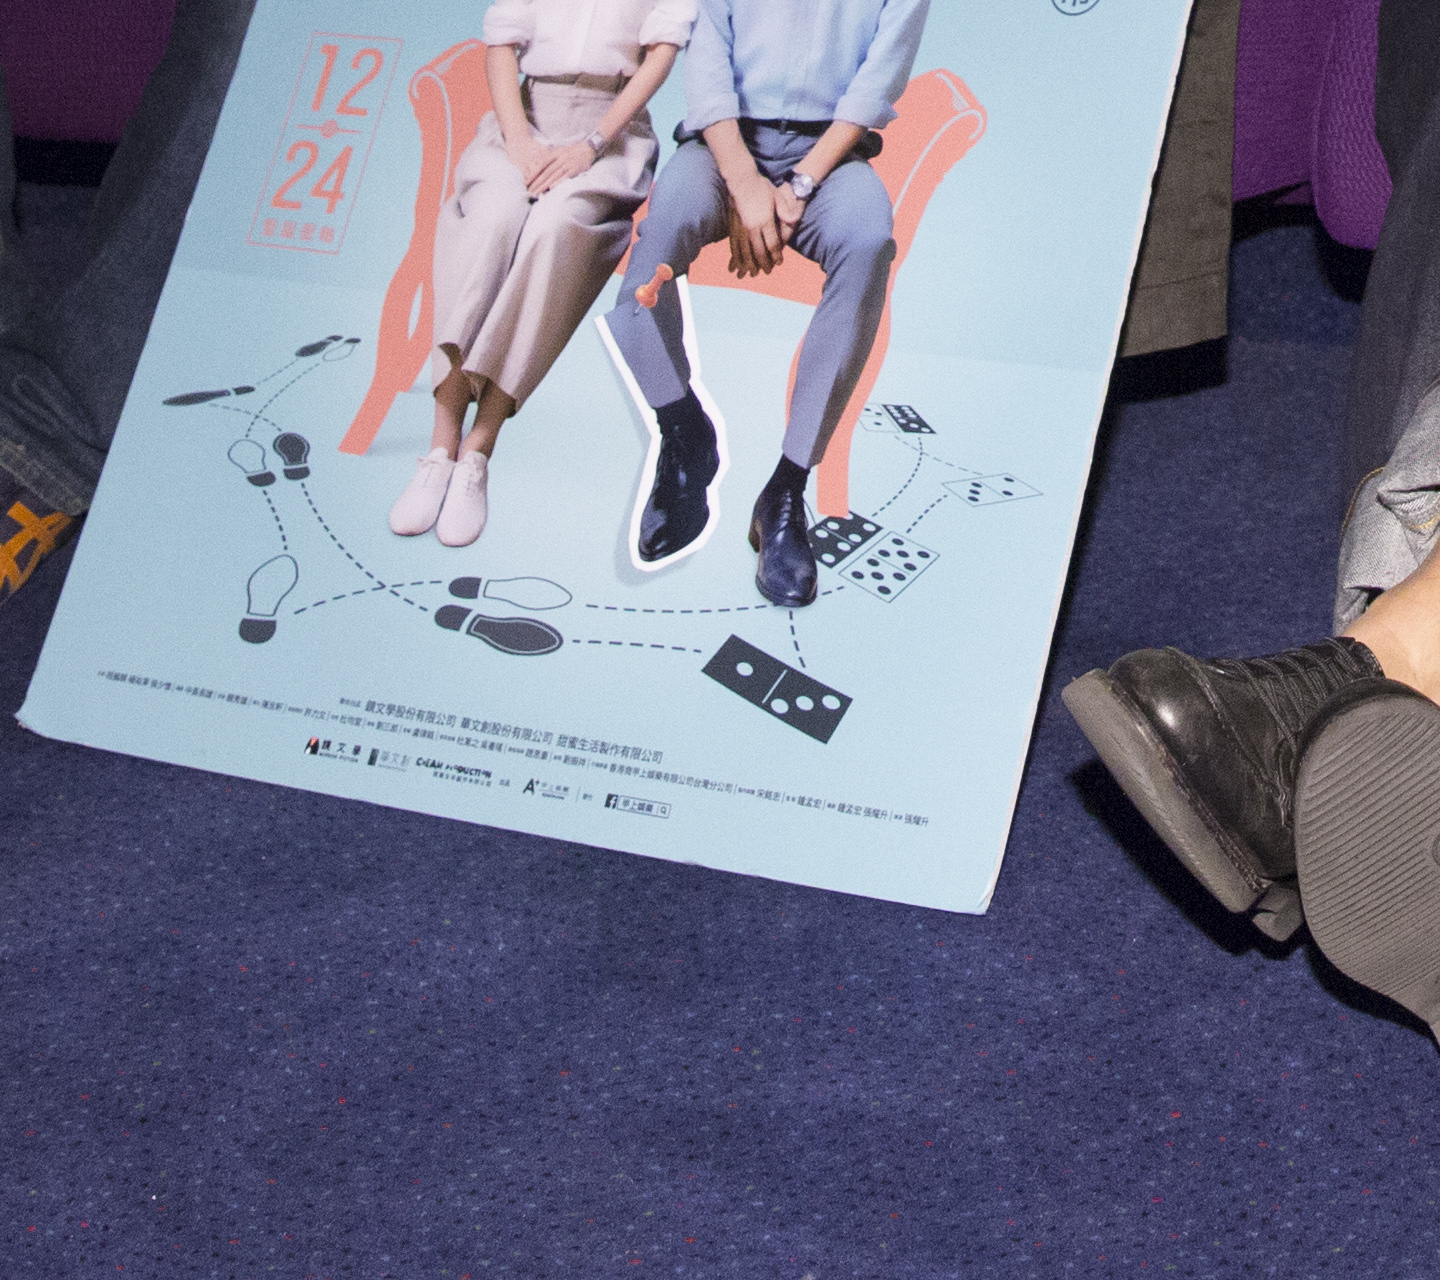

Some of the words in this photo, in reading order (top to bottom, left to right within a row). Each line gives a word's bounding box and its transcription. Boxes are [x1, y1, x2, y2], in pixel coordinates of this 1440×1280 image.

[311, 44, 384, 117] 12
[271, 140, 353, 214] 24
[556, 733, 663, 765] 甜蜜生活製作有限公司
